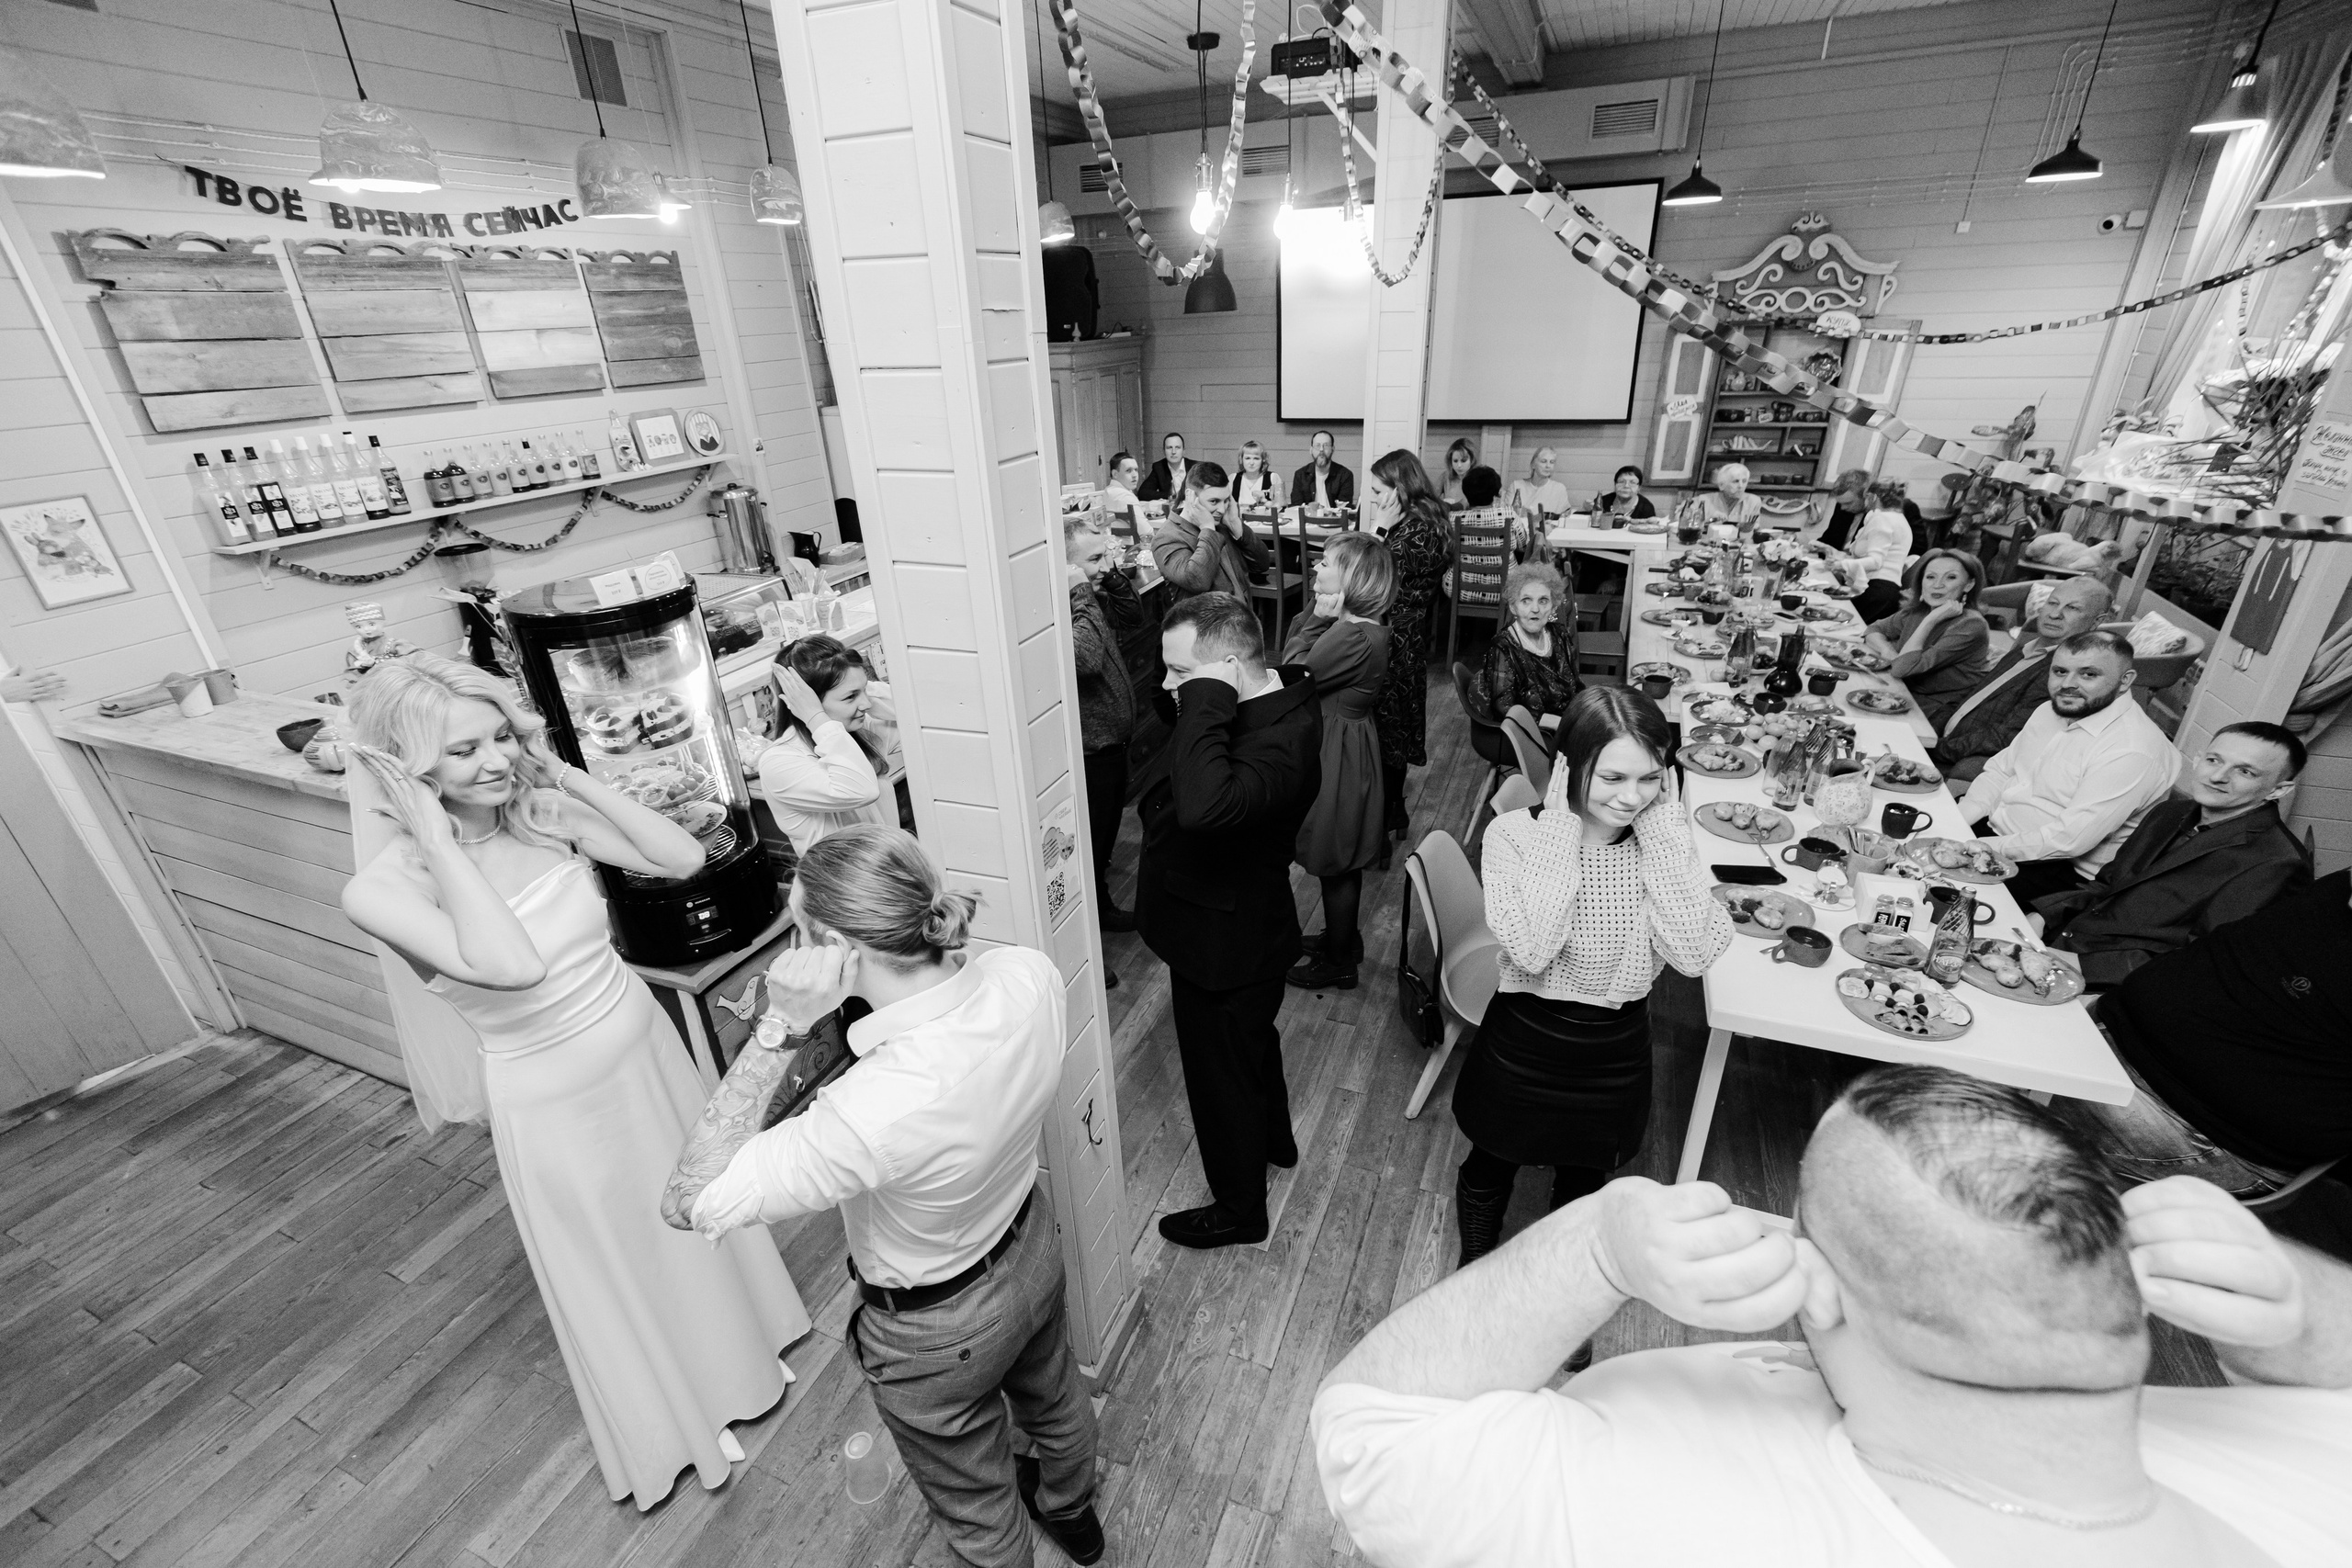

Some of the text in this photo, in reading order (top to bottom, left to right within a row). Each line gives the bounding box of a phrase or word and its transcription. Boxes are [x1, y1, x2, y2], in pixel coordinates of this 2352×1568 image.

[185, 165, 579, 238] ТВОЁ ВРЕМЯ СЕЙЧАС
